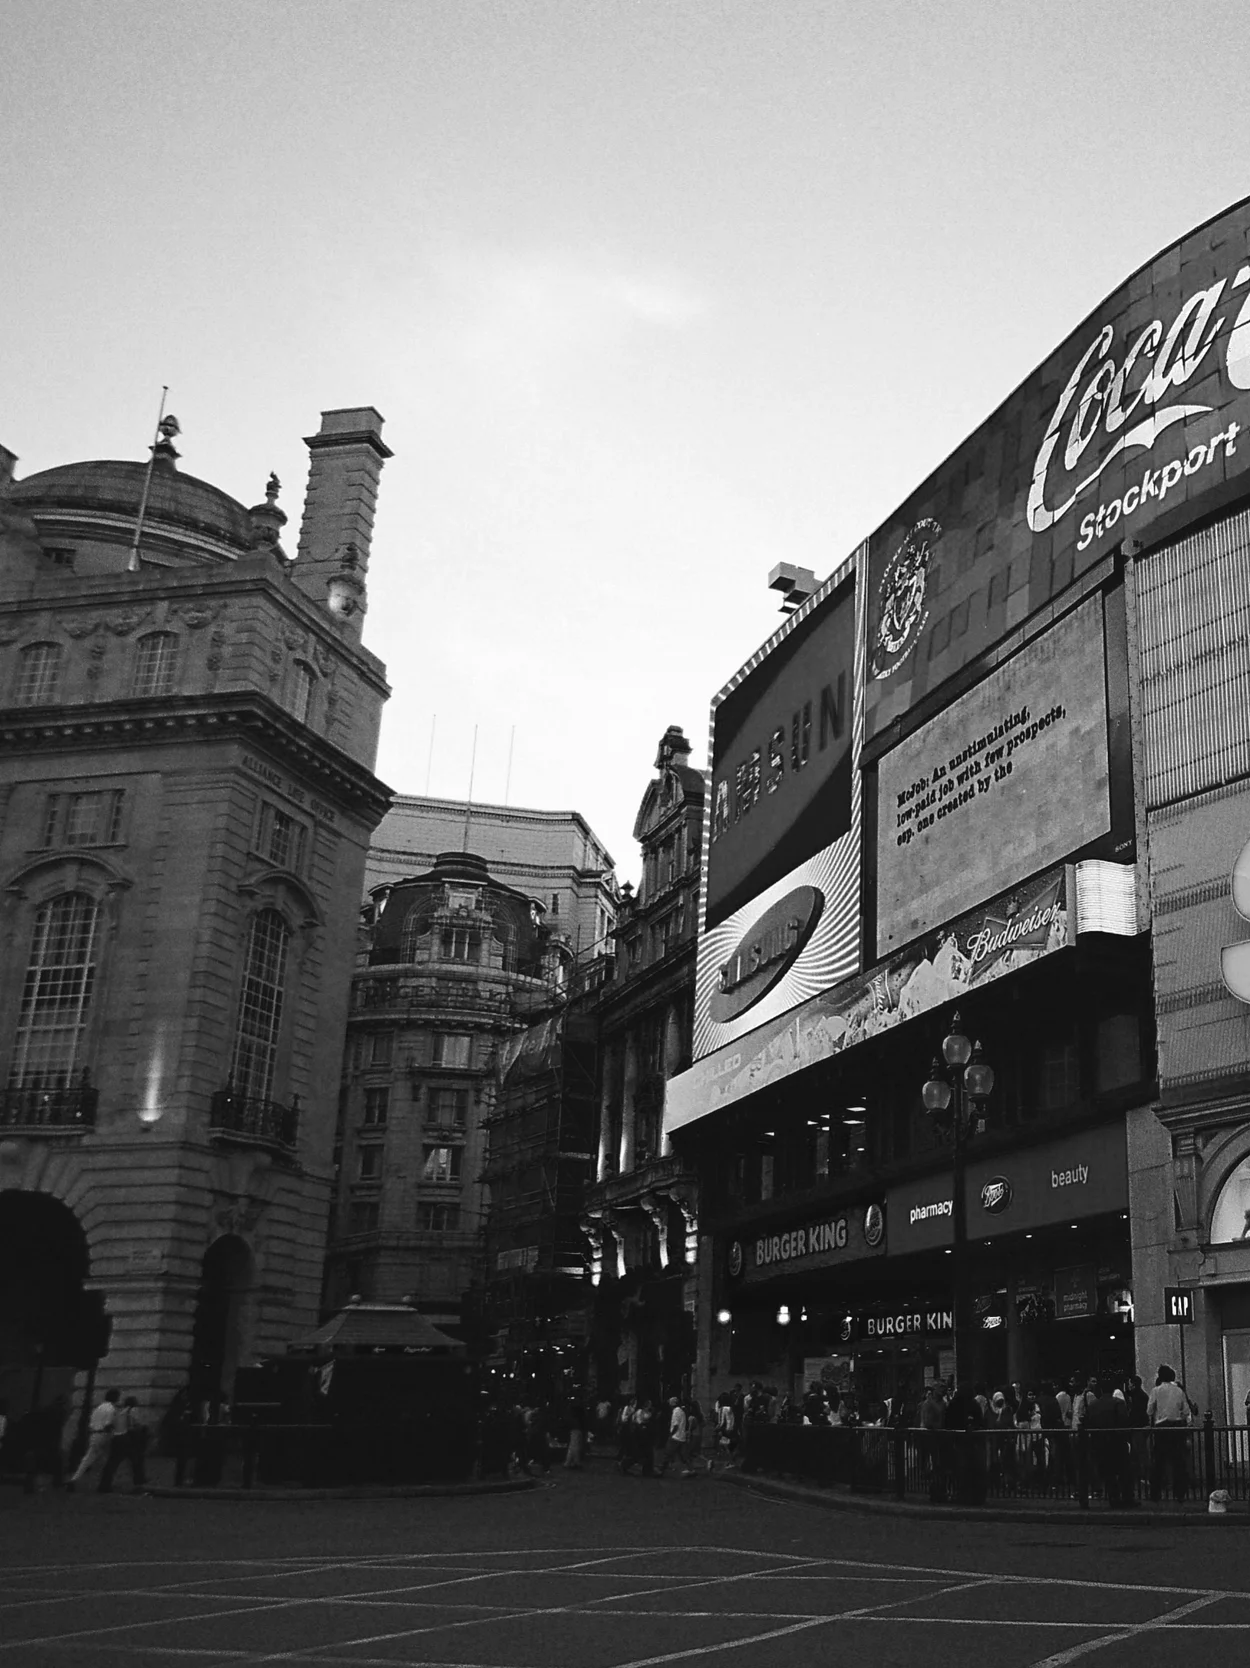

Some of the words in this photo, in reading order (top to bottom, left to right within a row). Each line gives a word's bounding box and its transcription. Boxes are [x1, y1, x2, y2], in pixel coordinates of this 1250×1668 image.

[1076, 420, 1240, 551] Stockport
[932, 766, 947, 784] An
[949, 705, 1031, 772] unstimulating,
[896, 790, 936, 828] low-paid
[938, 779, 955, 803] job
[956, 760, 982, 787] with
[984, 745, 1005, 768] few
[1006, 704, 1066, 757] prospects,
[917, 811, 935, 833] one
[936, 783, 976, 820] created
[977, 774, 991, 793] by
[994, 761, 1013, 783] the
[1114, 839, 1133, 853] SONY
[966, 902, 1061, 964] Budweiser
[1051, 1163, 1089, 1188] beauty
[909, 1199, 954, 1225] pharmacy
[755, 1229, 806, 1266] BURGER
[808, 1218, 848, 1254] KING
[867, 1313, 921, 1335] BURGER
[926, 1311, 953, 1331] KIN
[1062, 1302, 1088, 1314] pharmacy
[1171, 1295, 1189, 1317] GAP
